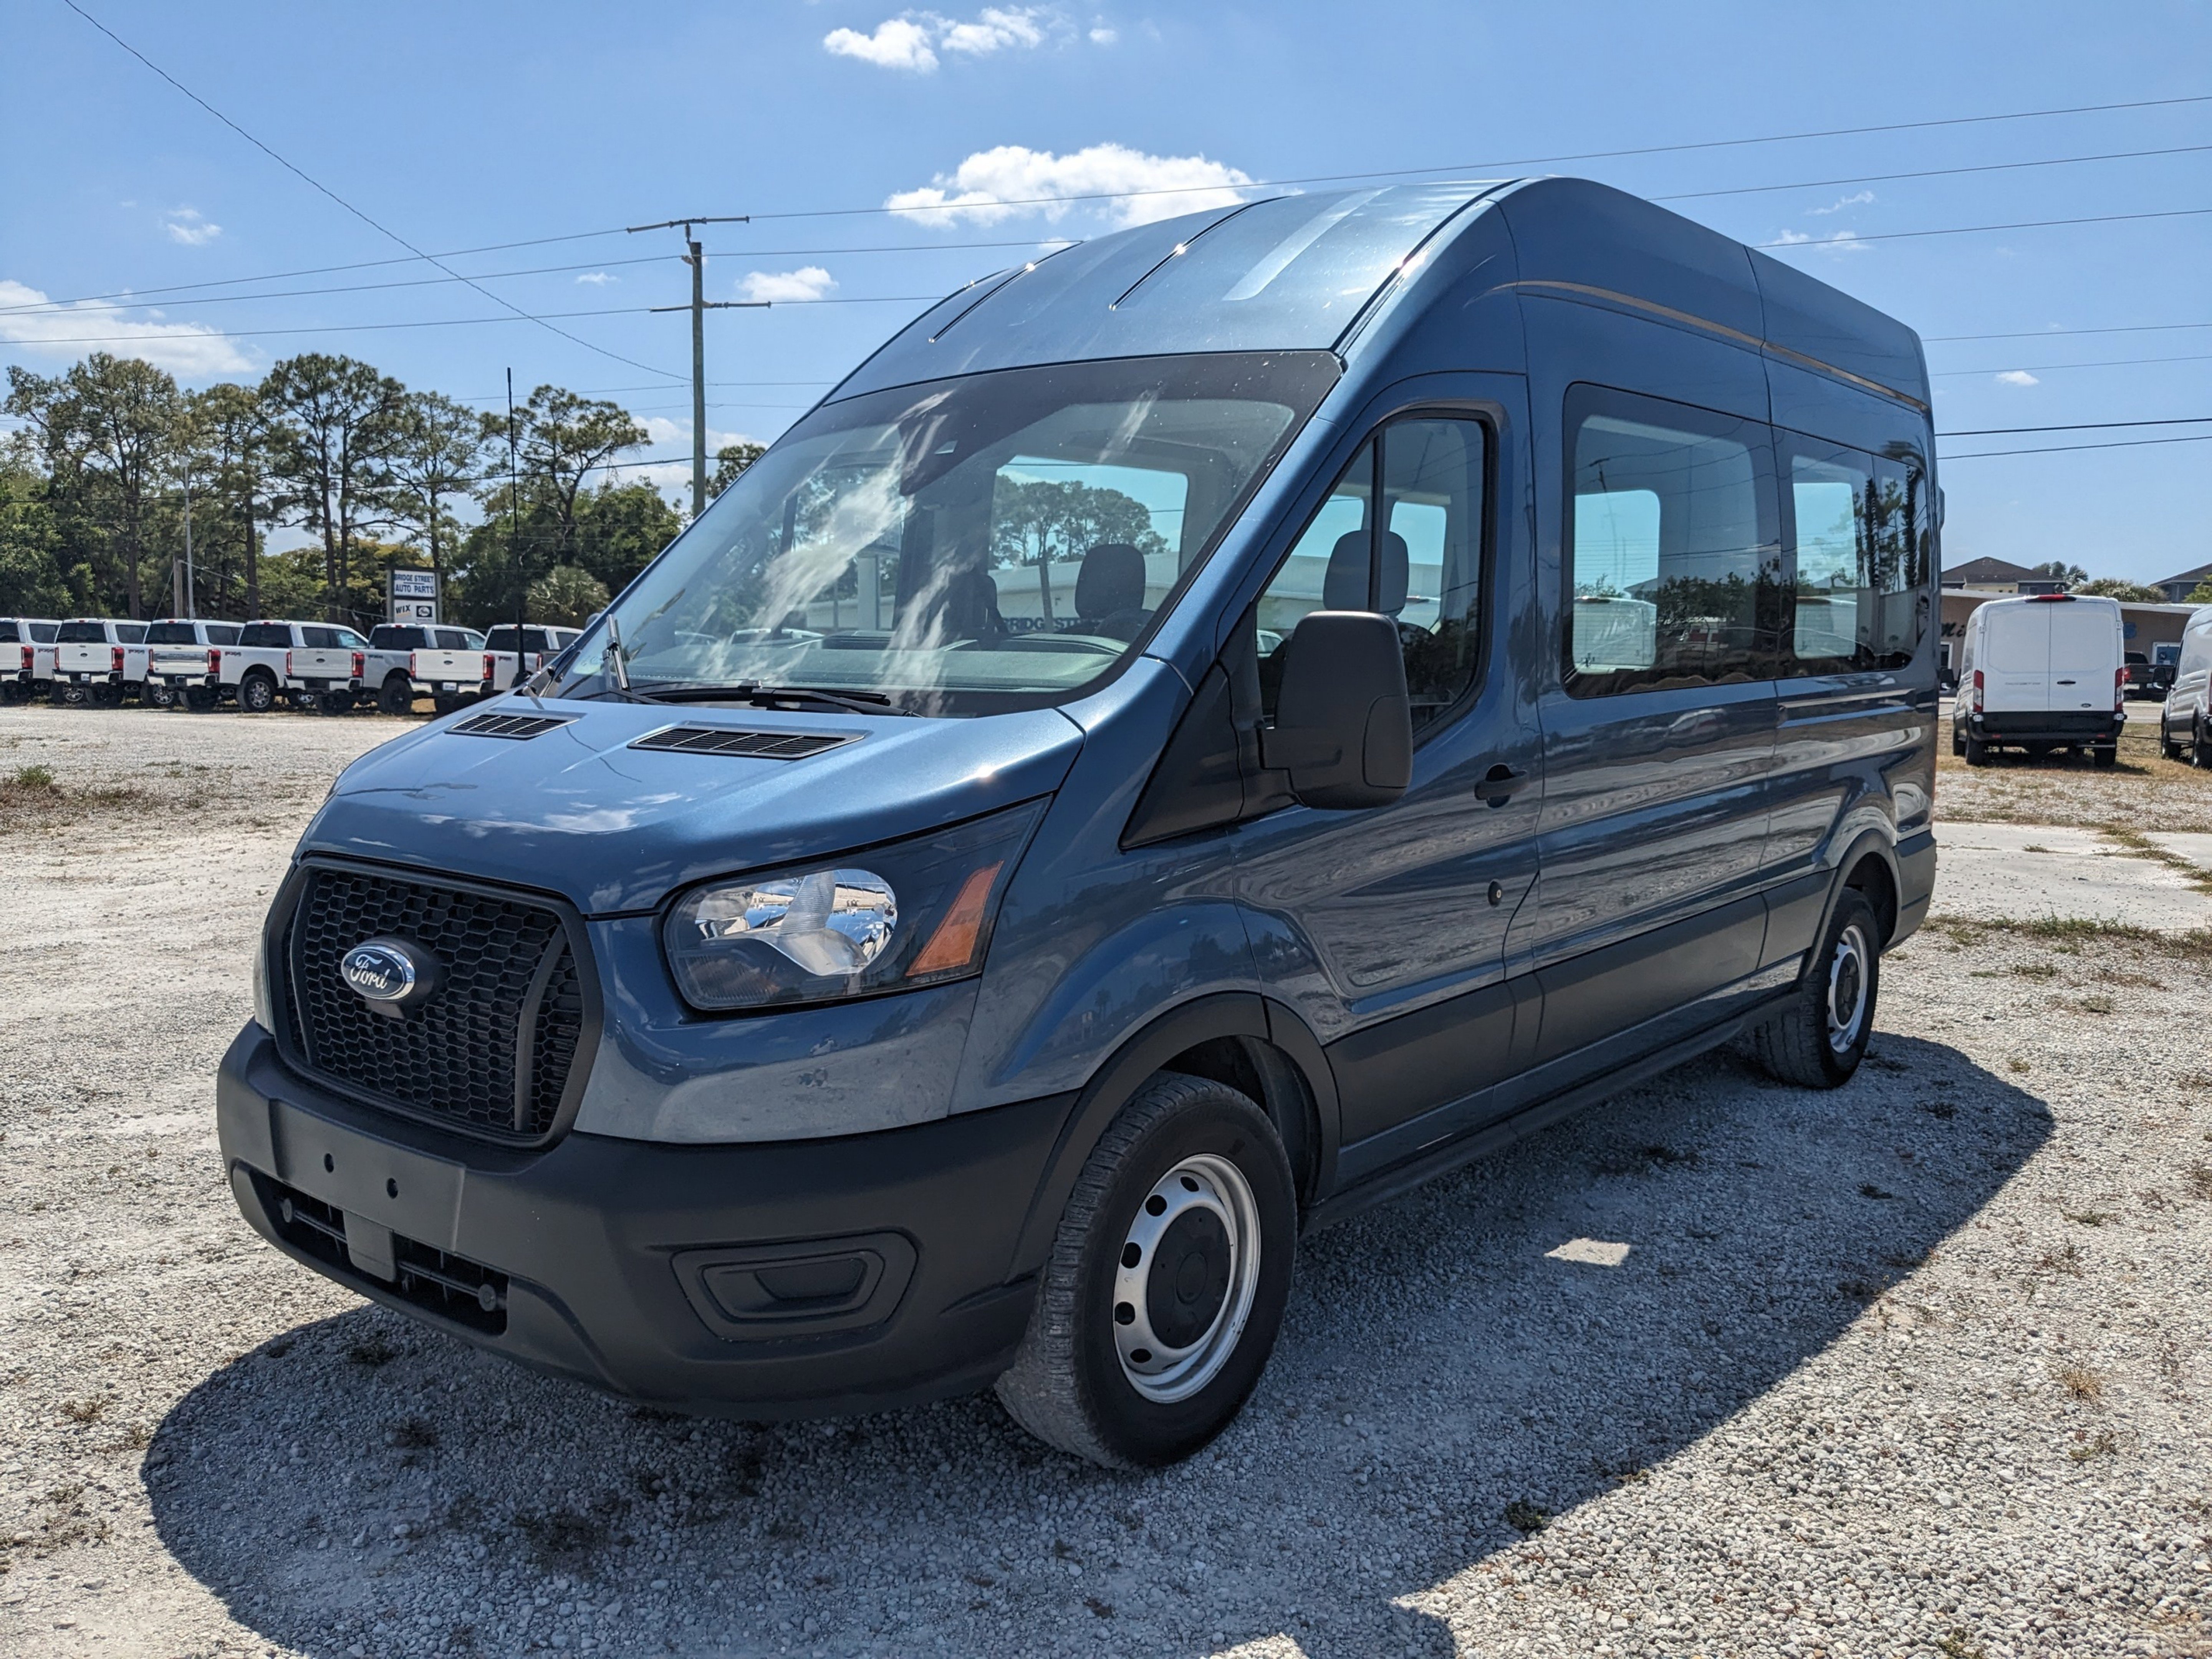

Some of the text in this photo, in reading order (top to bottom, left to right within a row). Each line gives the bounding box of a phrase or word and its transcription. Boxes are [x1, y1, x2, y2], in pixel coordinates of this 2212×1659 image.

[396, 584, 434, 594] AUTO PARTS
[395, 604, 410, 614] WIX
[350, 954, 391, 989] Ford
